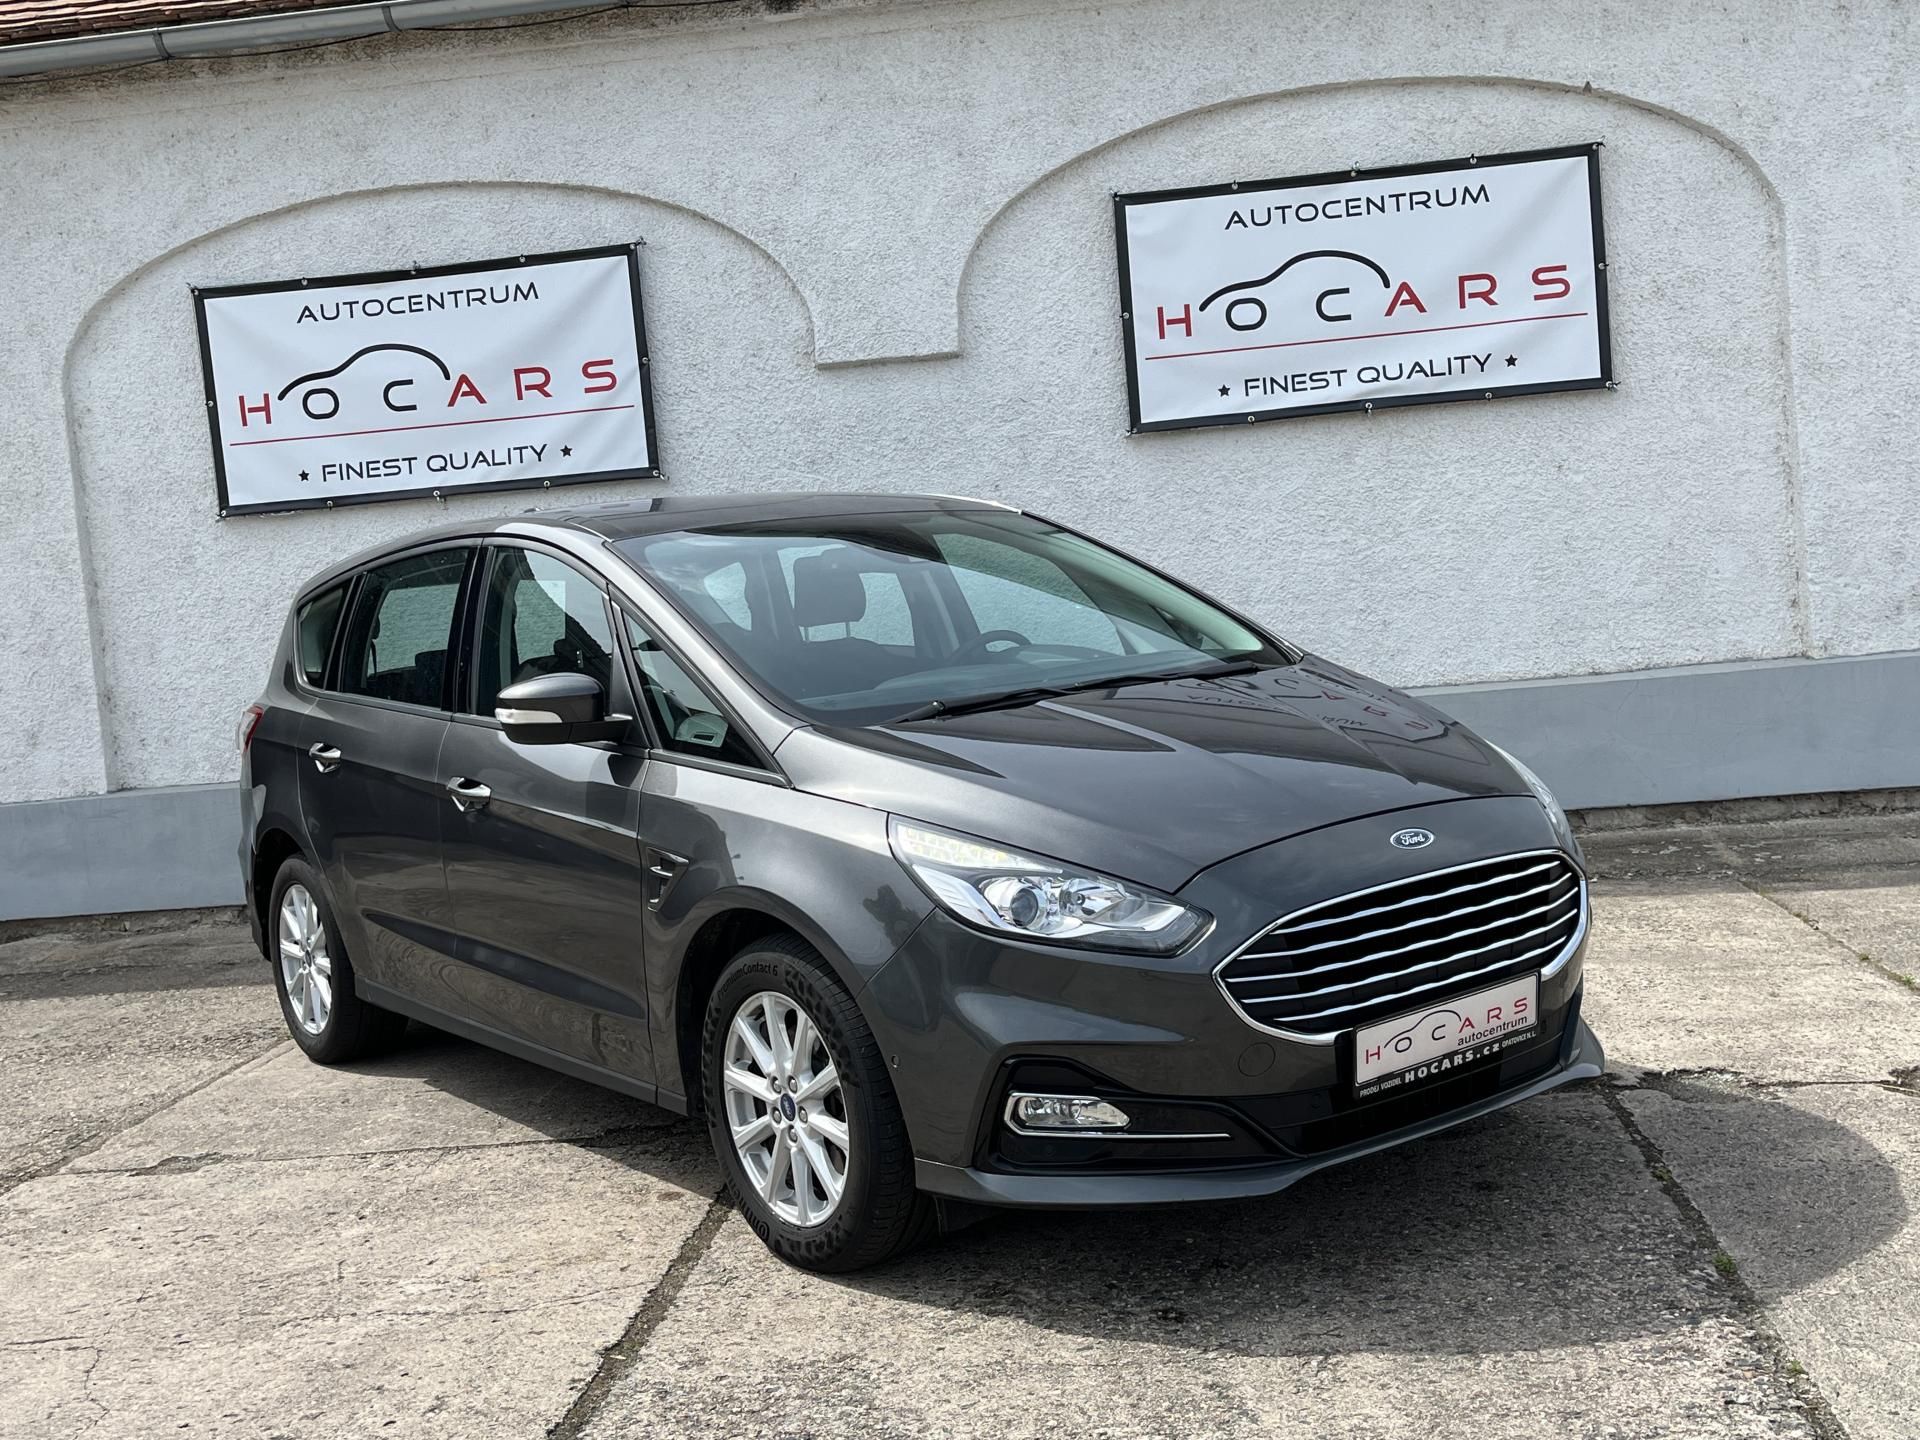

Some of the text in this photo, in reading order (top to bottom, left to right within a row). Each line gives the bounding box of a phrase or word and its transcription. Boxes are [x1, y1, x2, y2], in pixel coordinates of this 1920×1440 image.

[1224, 183, 1490, 230] AUTOCENTRUM
[296, 281, 539, 324] AUTOCENTRUM
[1244, 353, 1493, 397] FINEST QUALITY
[322, 443, 548, 482] FINEST QUALITY
[1400, 832, 1425, 845] Ford
[1457, 1015, 1527, 1046] autocentrum
[1359, 1086, 1380, 1098] PRODEJ
[1381, 1077, 1402, 1090] VOZIDEL
